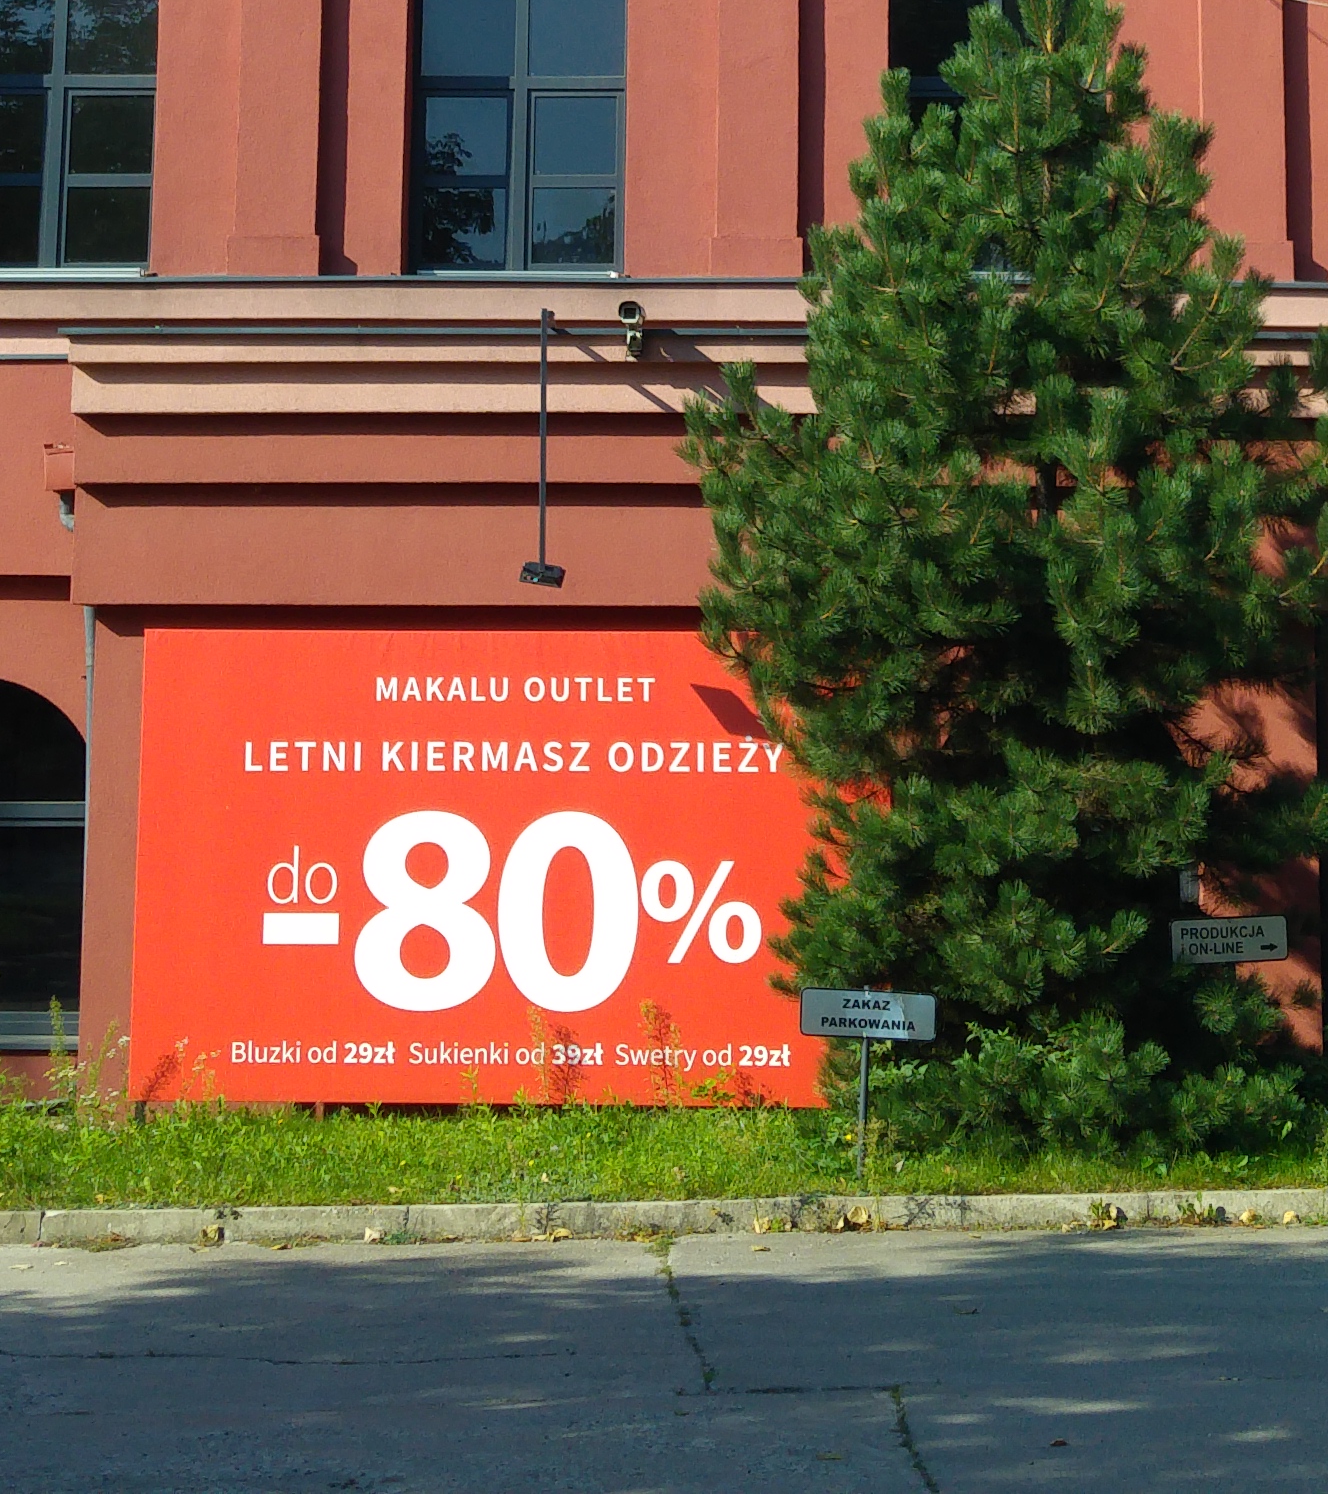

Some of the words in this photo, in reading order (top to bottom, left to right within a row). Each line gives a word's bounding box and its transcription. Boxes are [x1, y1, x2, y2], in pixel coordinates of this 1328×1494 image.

[375, 676, 510, 703] MAKALU
[523, 676, 657, 703] OUTLET
[243, 740, 362, 773] LETNI
[381, 740, 591, 773] KIERMASZ
[607, 735, 784, 774] ODZIEŻY
[267, 845, 339, 906] do
[262, 809, 763, 1013] -80%
[1180, 925, 1265, 940] PRODUKCJA
[1188, 941, 1245, 956] ON-LINE
[841, 998, 892, 1012] ZAKAZ
[820, 1016, 917, 1032] PARKOWANIA
[230, 1040, 302, 1064] Bluzki
[307, 1040, 337, 1064] od
[343, 1041, 396, 1064] 29zł
[408, 1041, 509, 1065] Sukienki
[515, 1042, 545, 1066] od
[551, 1042, 604, 1066] 39zł
[614, 1043, 696, 1072] Swetry
[702, 1043, 732, 1067] od
[738, 1043, 791, 1067] 29zł
